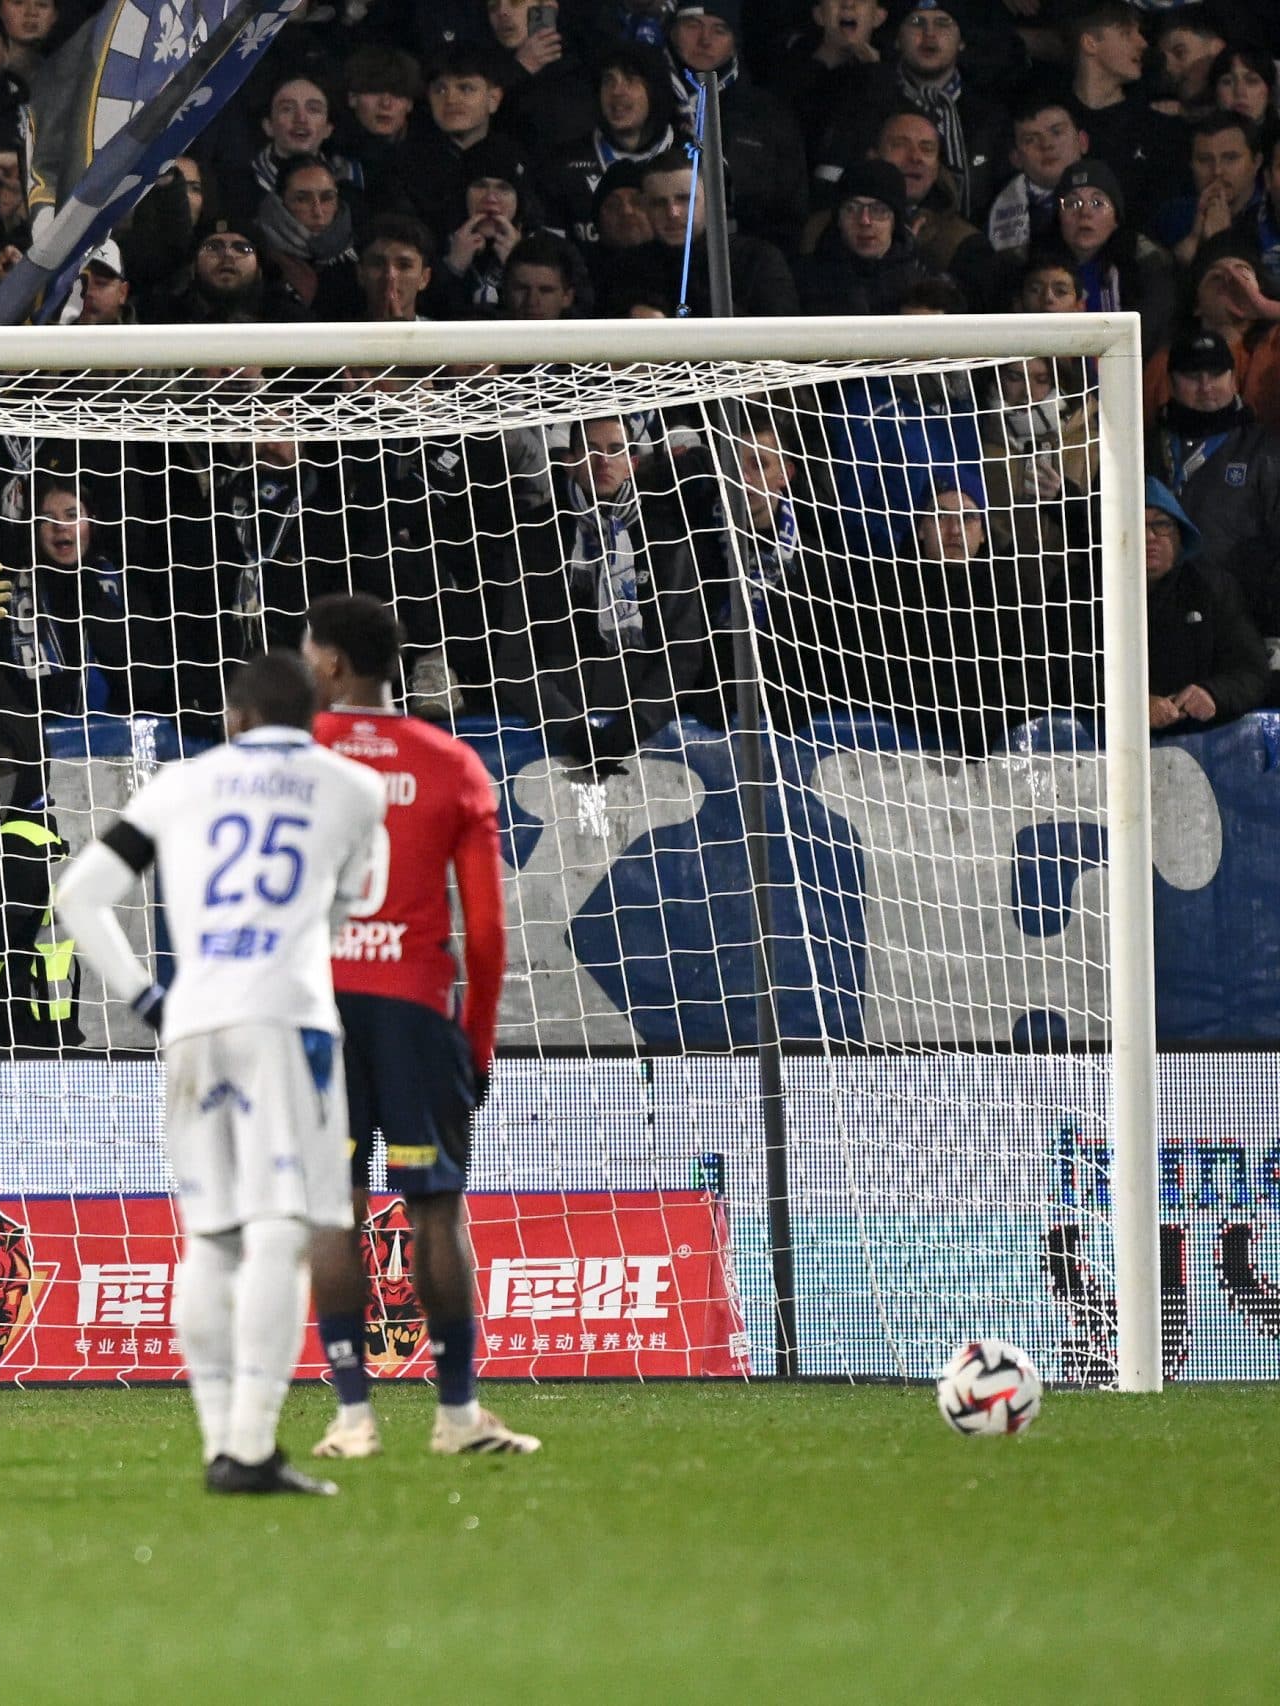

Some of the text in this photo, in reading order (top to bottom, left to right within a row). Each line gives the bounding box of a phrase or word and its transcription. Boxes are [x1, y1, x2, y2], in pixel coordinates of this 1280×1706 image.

[205, 812, 312, 908] 25
[77, 1263, 185, 1326] 犀
[487, 1256, 672, 1321] 犀旺
[486, 1332, 668, 1351] 专业运动营养饮料
